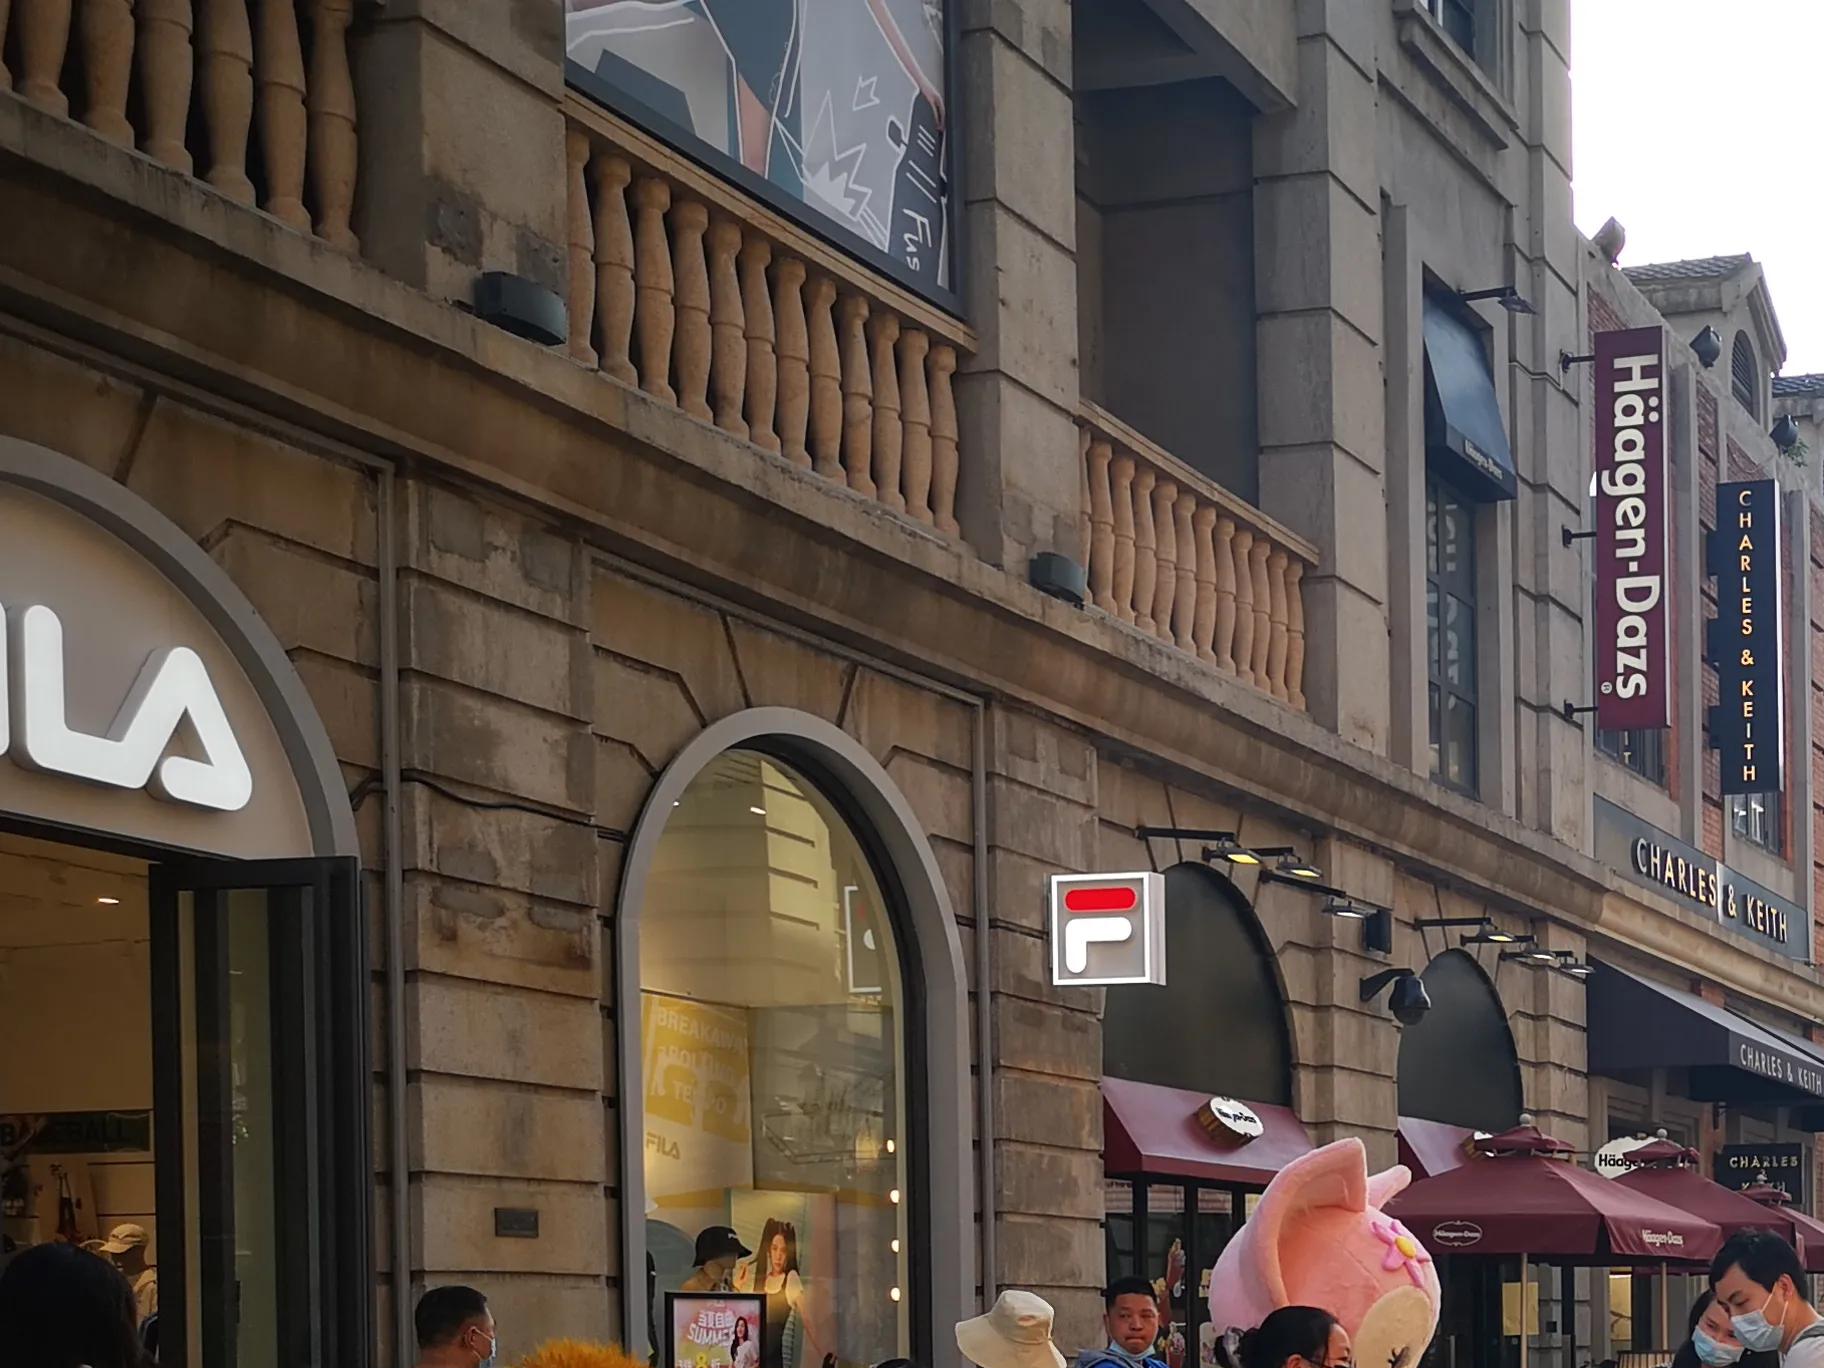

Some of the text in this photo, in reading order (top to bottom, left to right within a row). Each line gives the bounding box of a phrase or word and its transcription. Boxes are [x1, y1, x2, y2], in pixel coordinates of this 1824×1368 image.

[1602, 353, 1661, 699] Häagen-Dazs
[1738, 490, 1756, 782] CHARLES & KEITH
[1636, 837, 1788, 943] CHARLES & KEITH
[1739, 1043, 1823, 1095] CHARLES & KEITH
[645, 1131, 681, 1160] FILA
[1729, 1155, 1798, 1169] CHARLES
